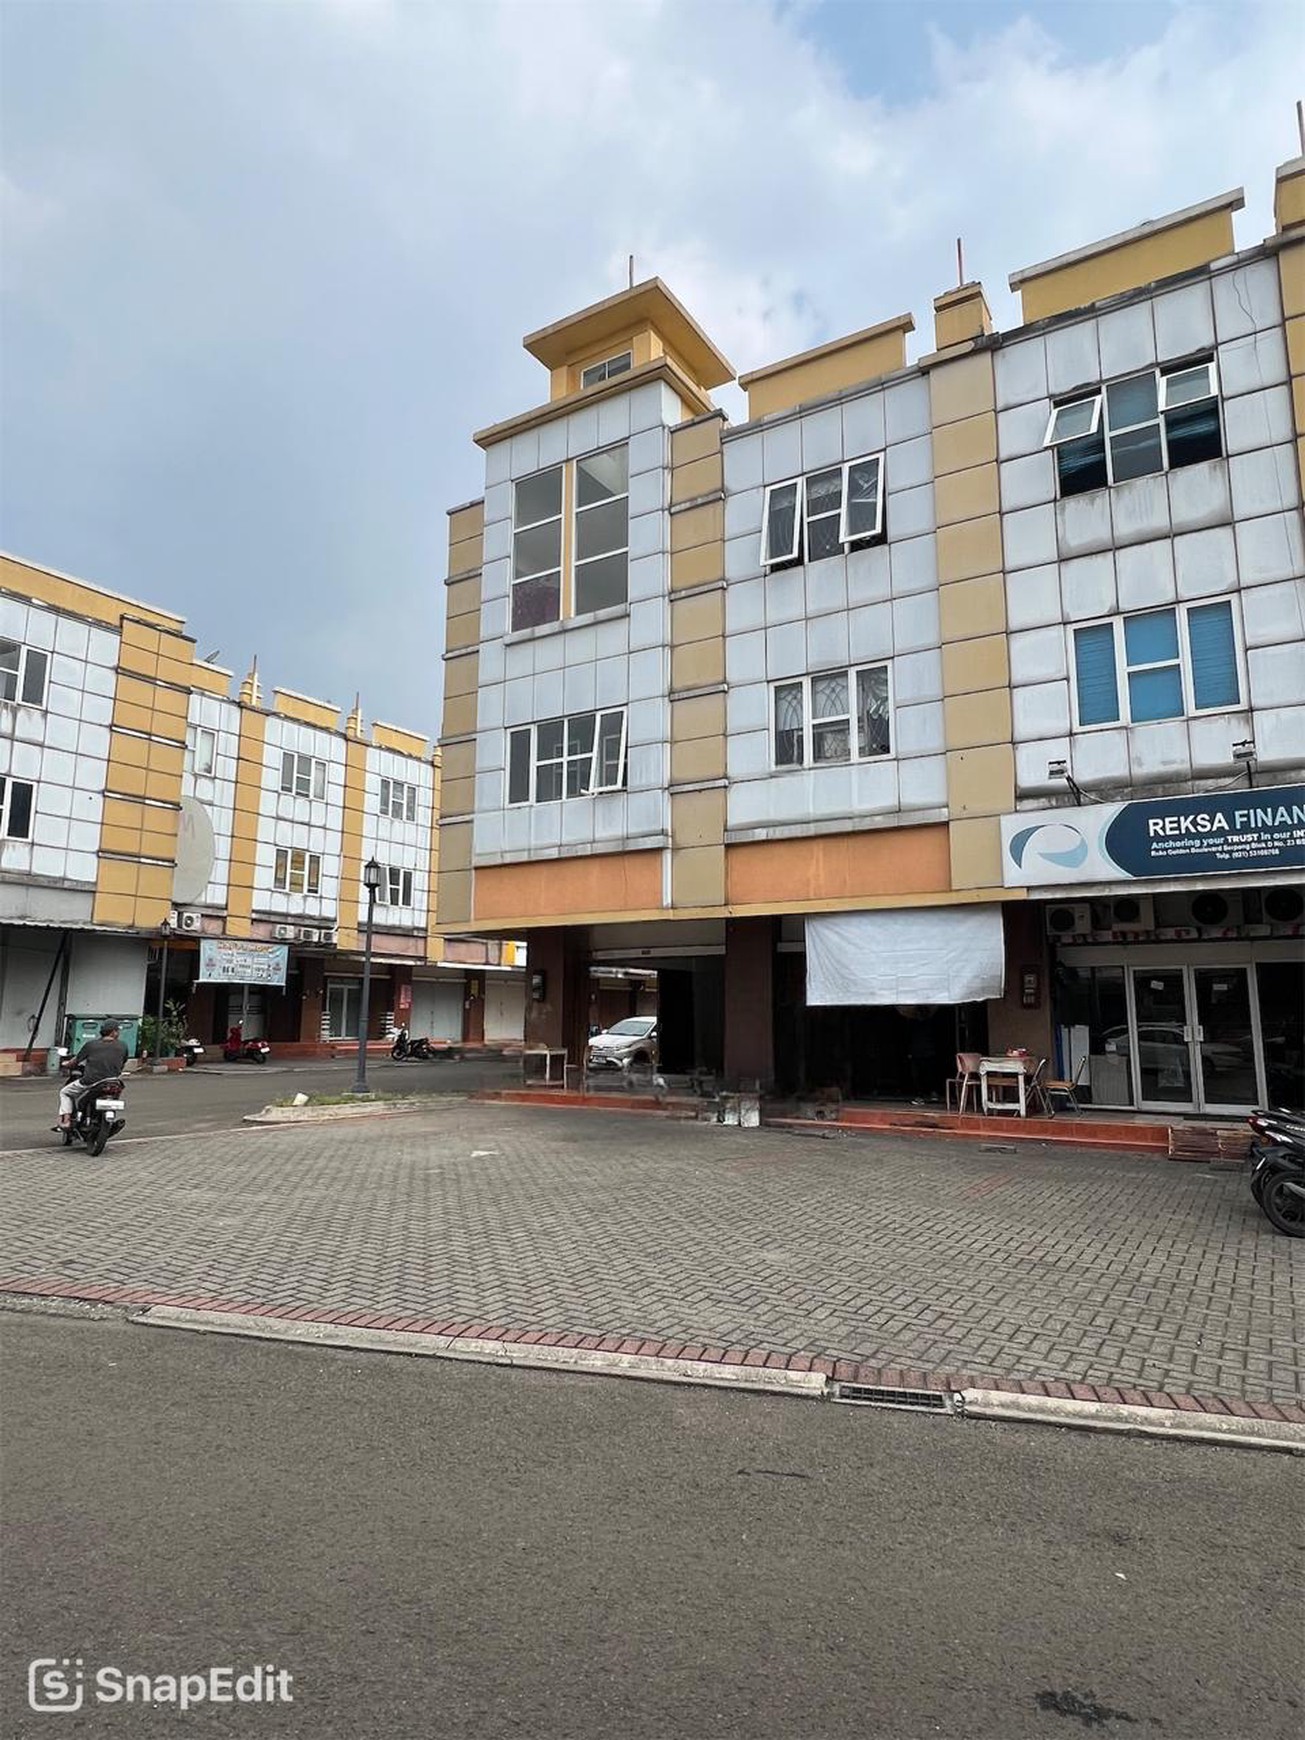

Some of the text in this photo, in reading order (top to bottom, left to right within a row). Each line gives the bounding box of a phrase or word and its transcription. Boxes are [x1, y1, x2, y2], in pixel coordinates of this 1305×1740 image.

[1148, 804, 1305, 837] REKSA FINAN
[1151, 838, 1201, 850] Anchoring
[1202, 837, 1225, 848] your
[1226, 833, 1259, 843] TRUST
[1273, 831, 1291, 839] our
